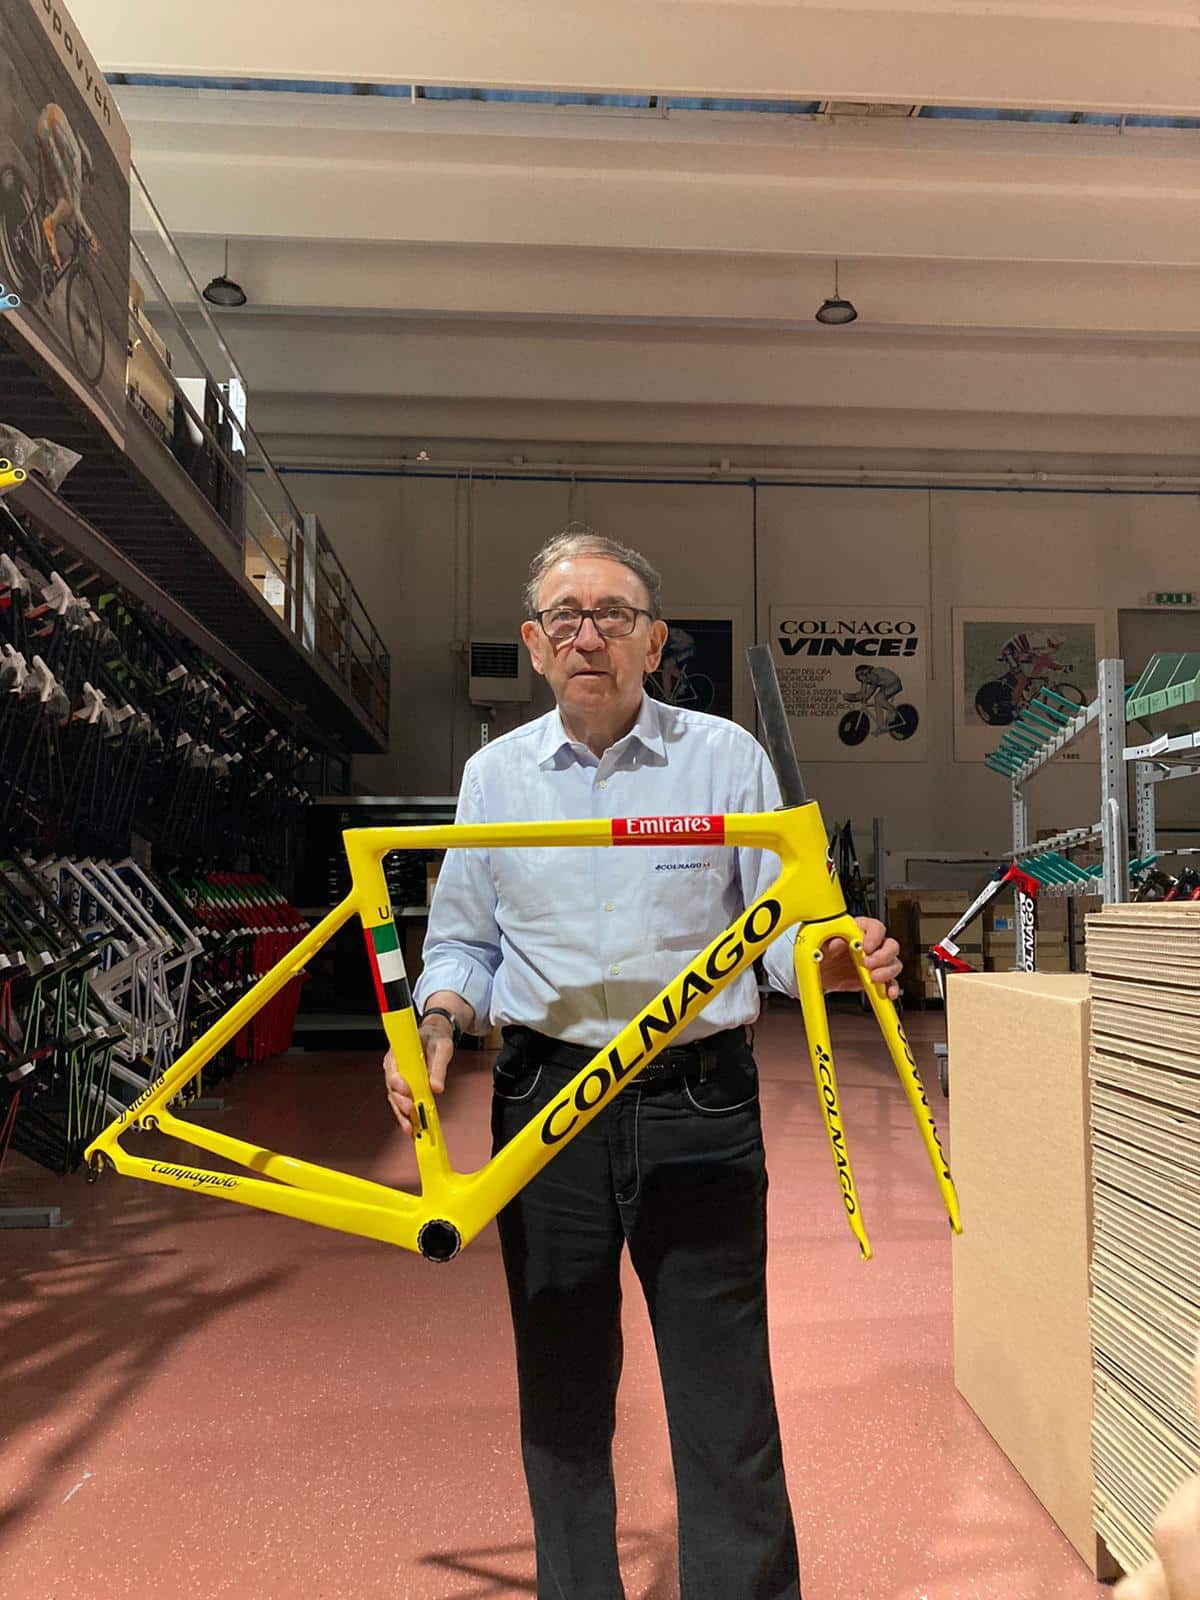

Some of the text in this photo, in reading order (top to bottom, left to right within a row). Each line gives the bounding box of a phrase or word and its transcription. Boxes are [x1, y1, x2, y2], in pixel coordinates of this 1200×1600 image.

[779, 620, 916, 635] COLNAGO
[778, 637, 919, 657] VINCE!
[626, 816, 711, 834] Emirates
[660, 862, 702, 871] COLNAGO
[1025, 898, 1035, 973] OLNAGO
[541, 899, 782, 1145] COLNAGO
[819, 1063, 855, 1215] COLNAGO
